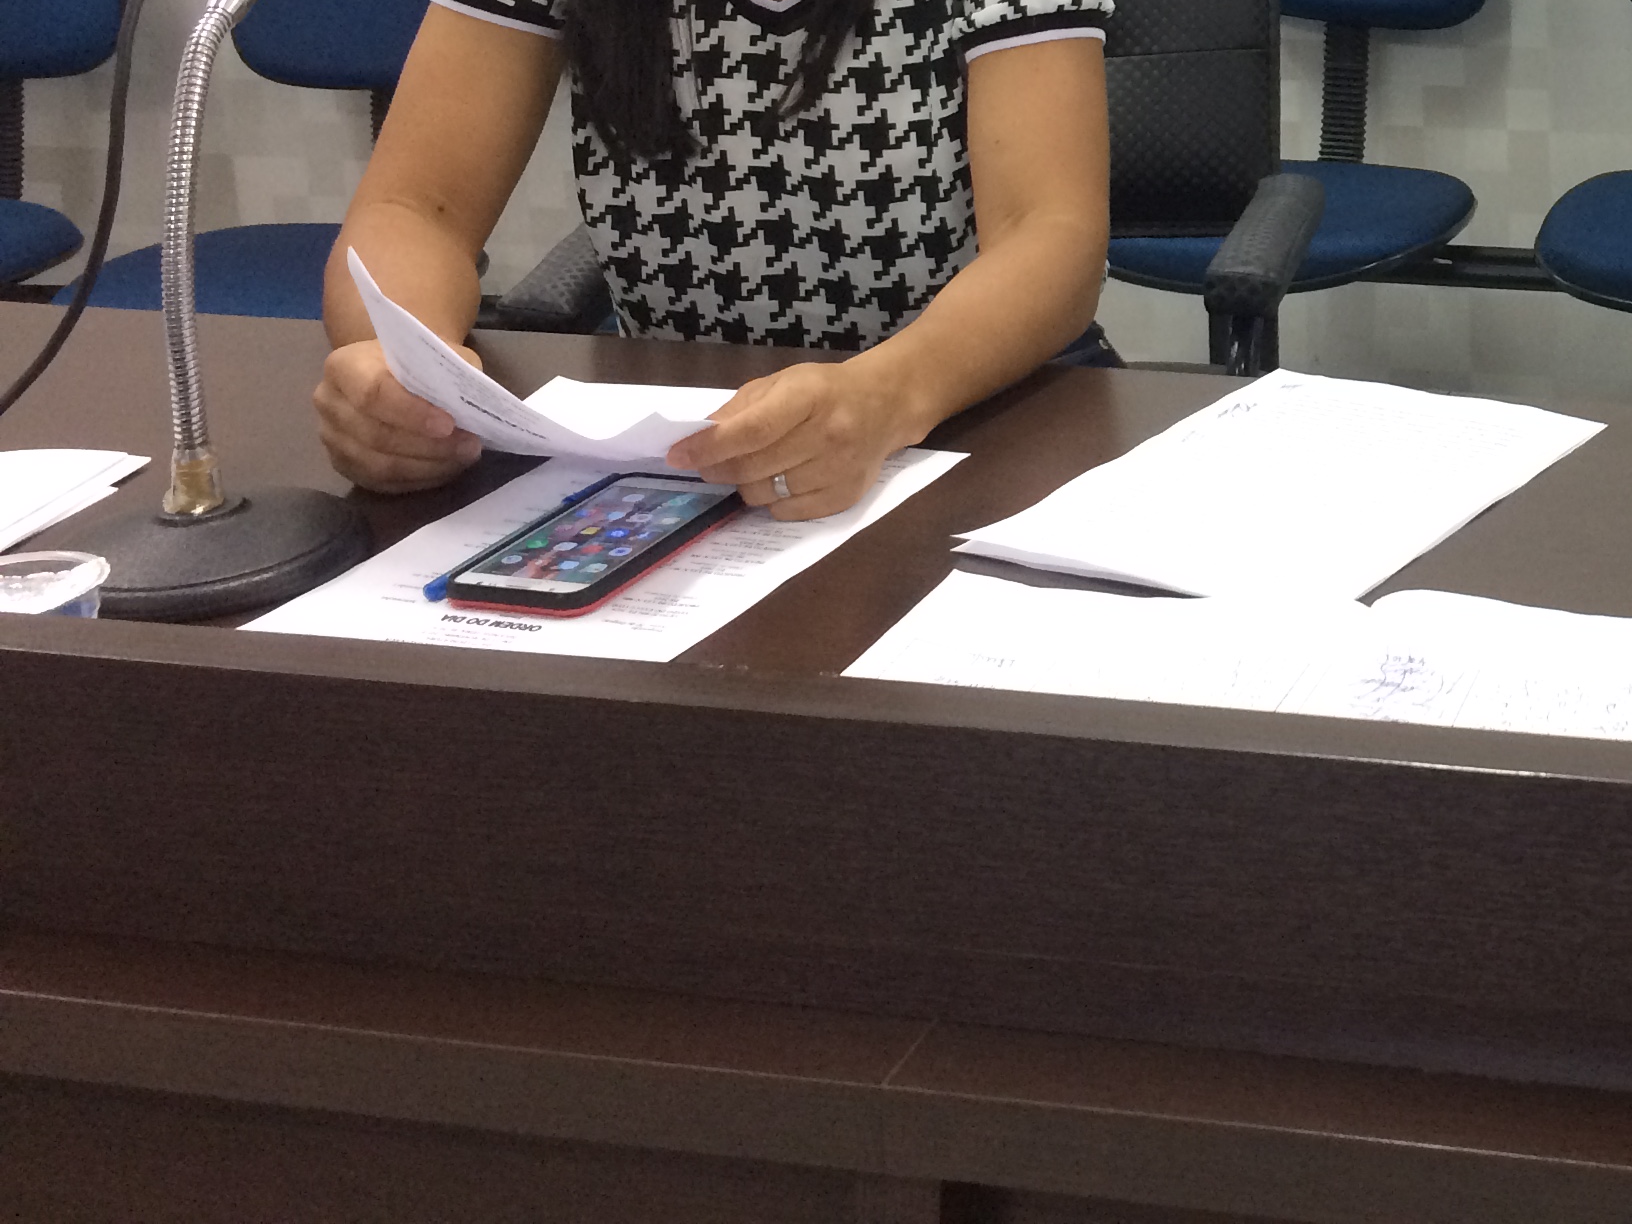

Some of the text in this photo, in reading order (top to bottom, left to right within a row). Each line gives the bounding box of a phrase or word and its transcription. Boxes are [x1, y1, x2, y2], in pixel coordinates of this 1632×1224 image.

[440, 614, 542, 632] ORDEM DO DIA
